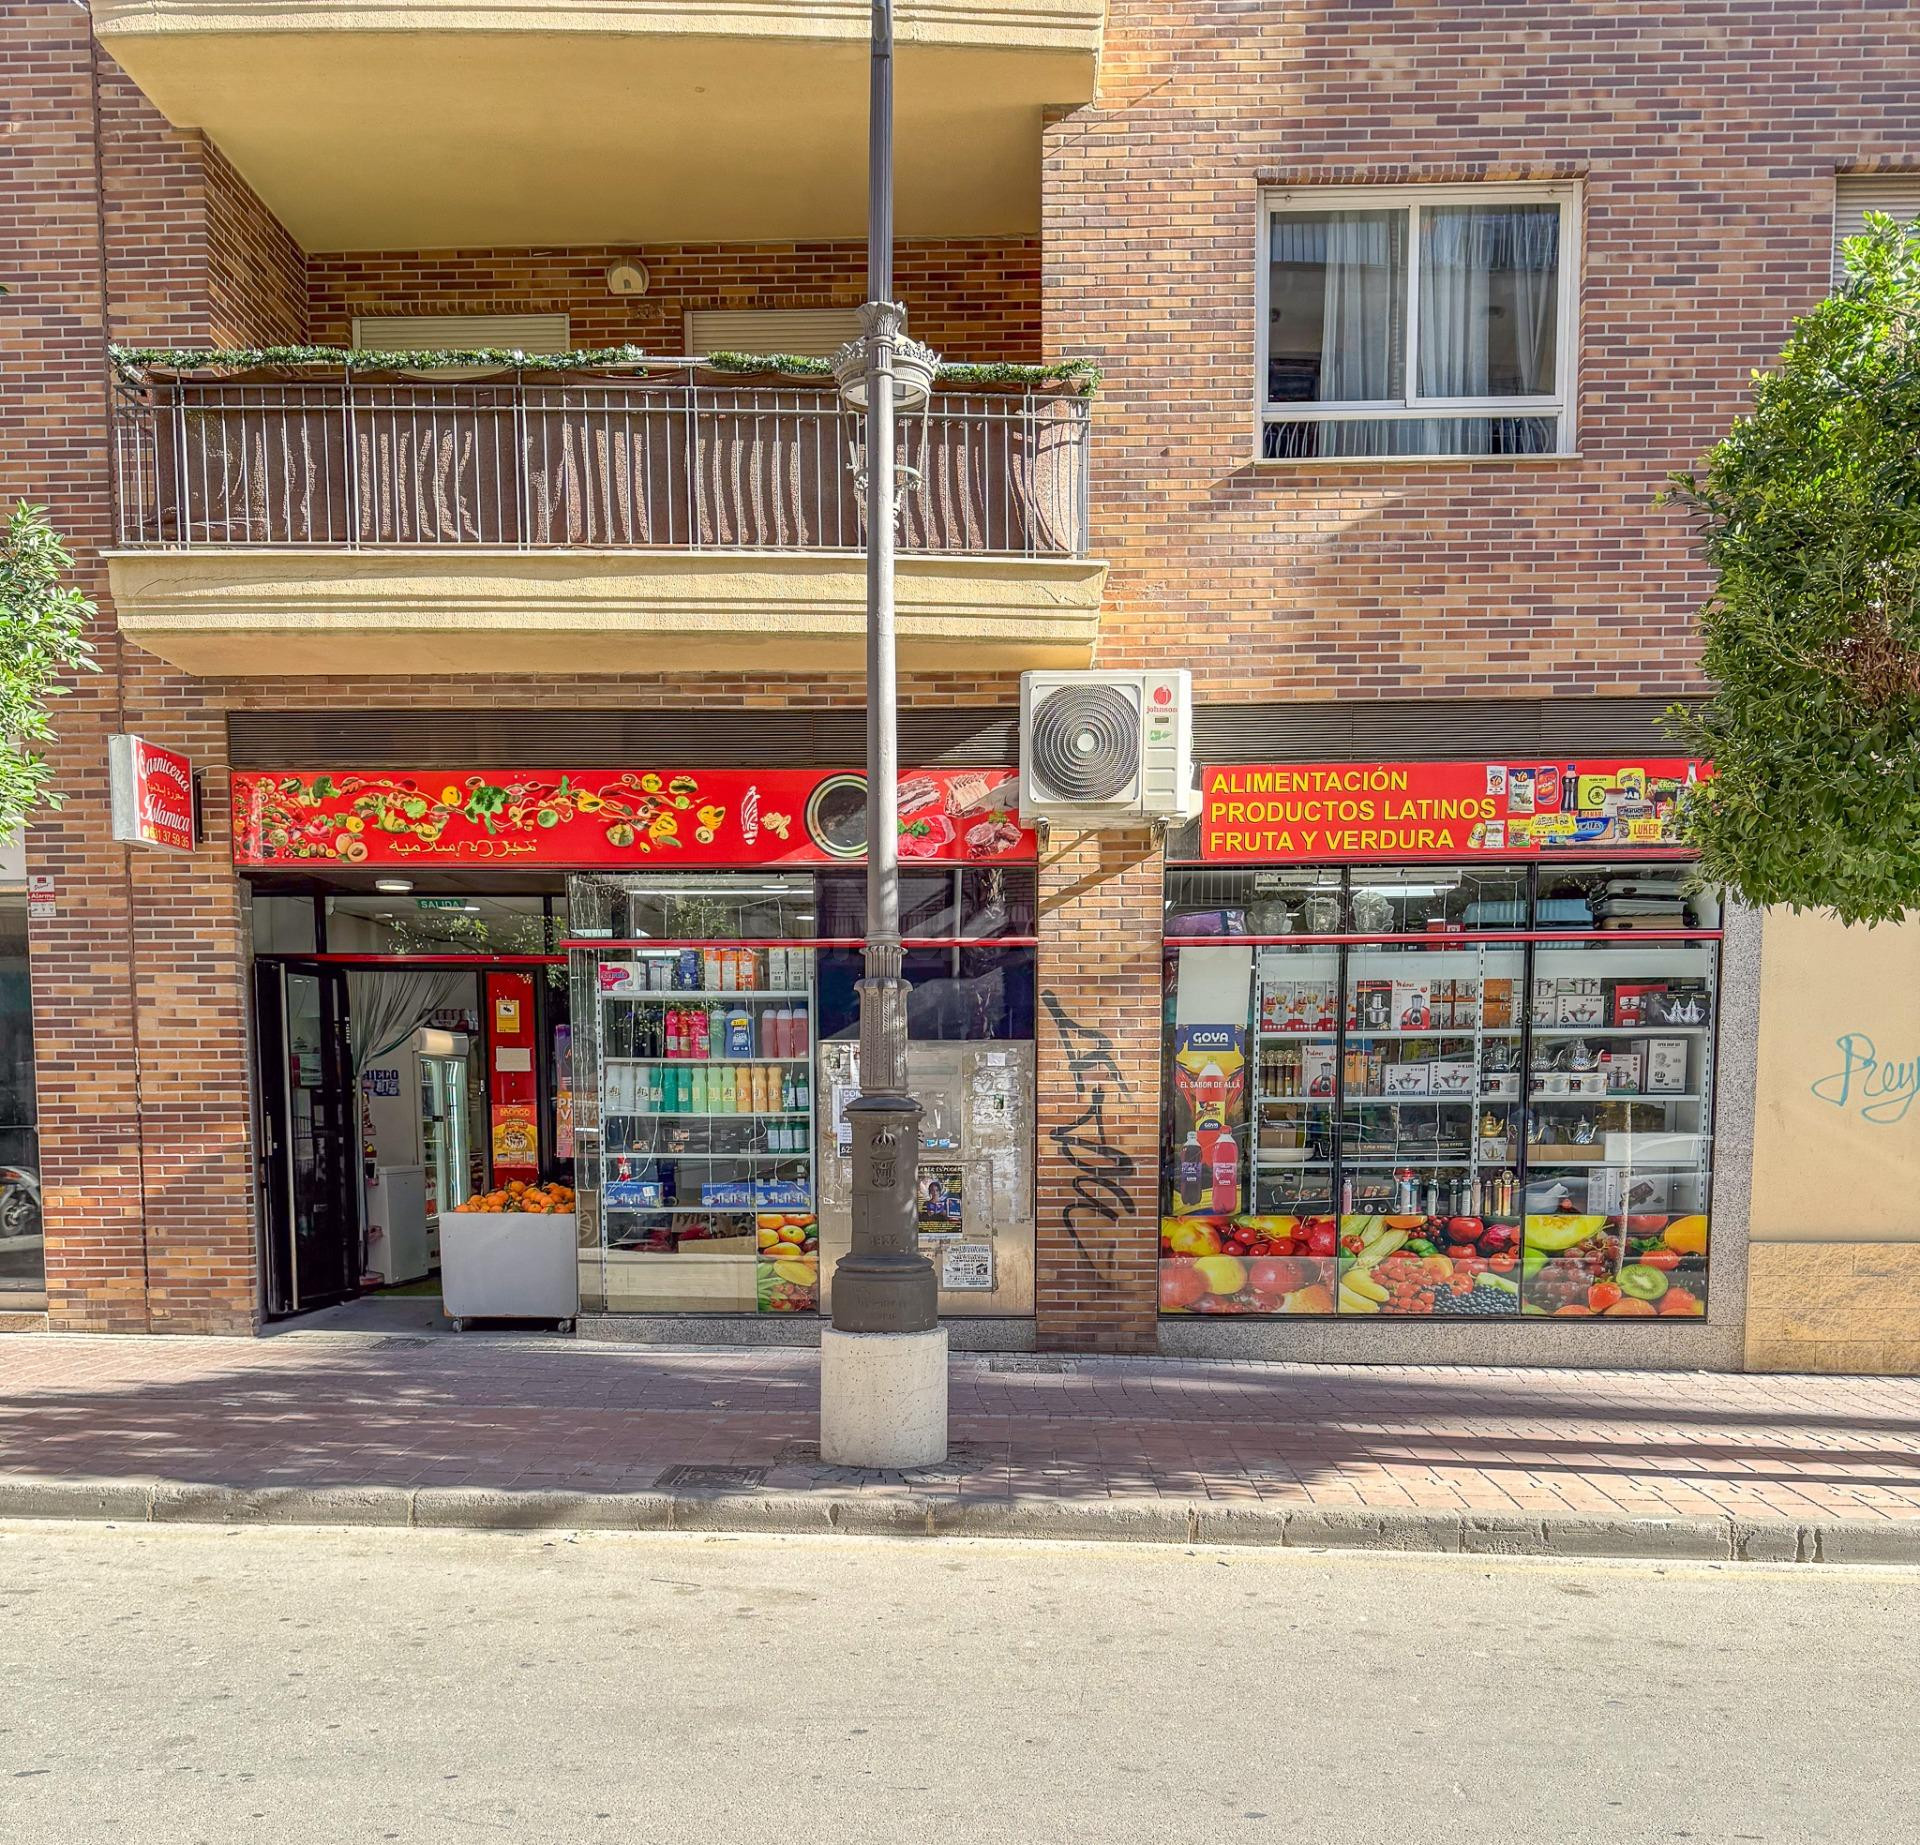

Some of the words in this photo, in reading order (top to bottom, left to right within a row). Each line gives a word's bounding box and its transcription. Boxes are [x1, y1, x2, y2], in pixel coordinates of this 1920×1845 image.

[1210, 766, 1409, 794] ALIMENTACIÓN
[1210, 800, 1375, 823] PRODUCTOS
[1383, 798, 1497, 820] LATINOS
[1633, 823, 1659, 835] LUKER
[162, 831, 171, 843] 37
[1210, 831, 1295, 852] FRUTA
[1300, 830, 1318, 850] Y
[1325, 829, 1455, 850] VERDURA
[420, 900, 460, 909] SALIDA
[1192, 1032, 1229, 1044] GOYA
[1189, 1081, 1213, 1089] SABOR
[1214, 1081, 1222, 1089] DE
[1223, 1079, 1241, 1089] ALLÁ
